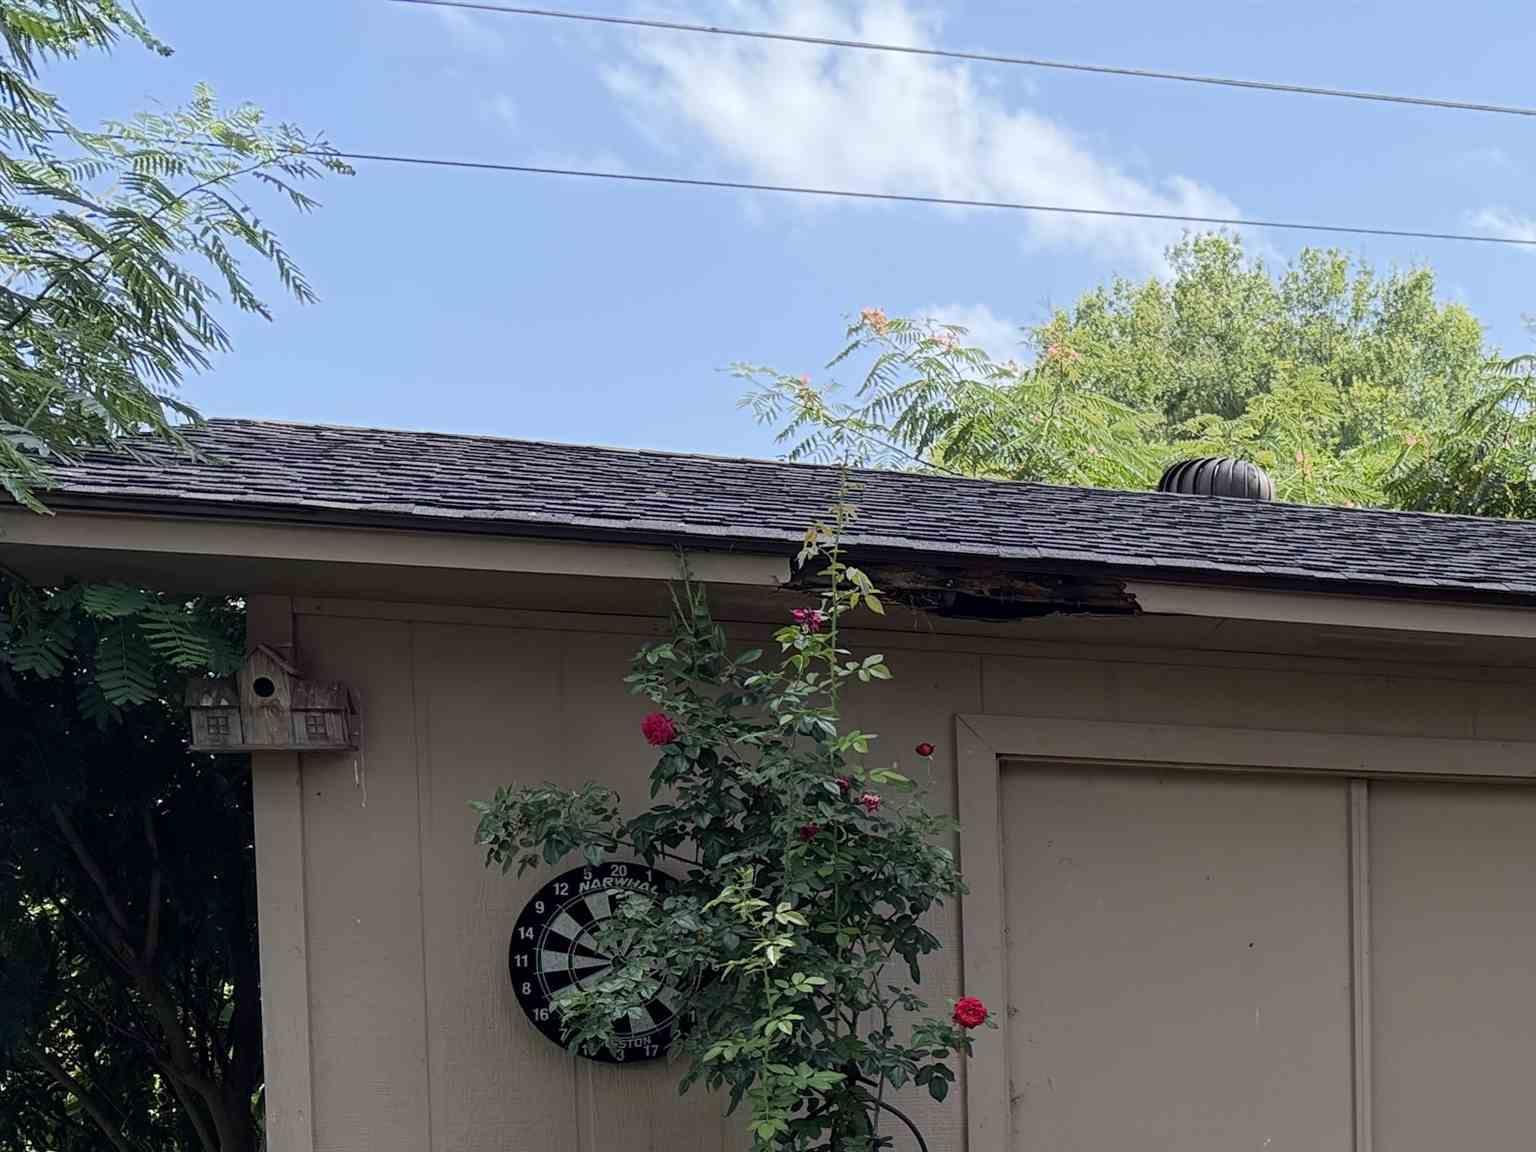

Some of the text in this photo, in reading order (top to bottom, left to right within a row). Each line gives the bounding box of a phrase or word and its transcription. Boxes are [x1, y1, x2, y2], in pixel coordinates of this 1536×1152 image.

[584, 868, 593, 880] 5
[610, 864, 627, 877] 20
[646, 870, 653, 882] 1
[553, 883, 569, 896] 12
[579, 877, 659, 896] NARWHAL
[535, 900, 545, 914] 9
[518, 927, 534, 940] 14
[514, 954, 529, 967] 11
[522, 982, 532, 995] 8
[533, 1008, 550, 1021] 16
[615, 1049, 625, 1062] 3
[643, 1045, 659, 1057] 17
